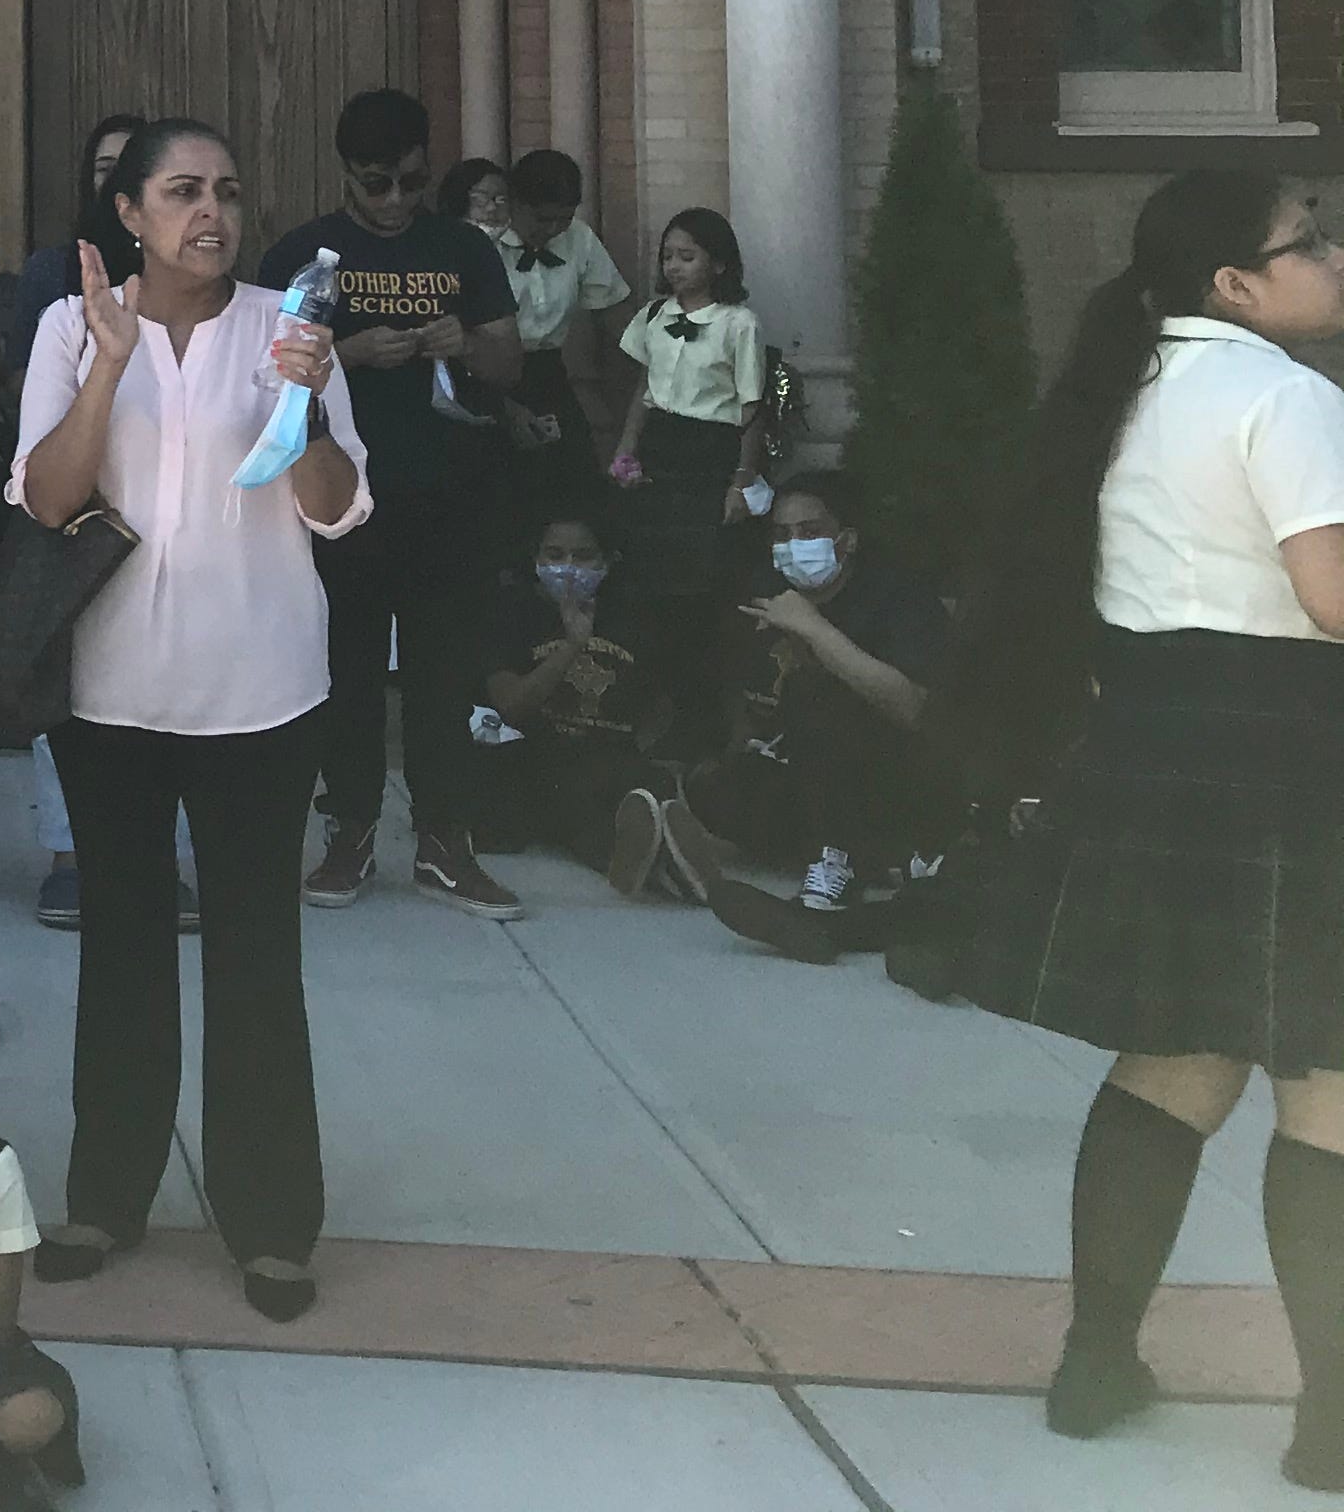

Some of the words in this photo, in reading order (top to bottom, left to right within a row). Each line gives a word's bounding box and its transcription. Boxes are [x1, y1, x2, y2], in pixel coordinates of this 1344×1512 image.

[334, 270, 402, 294] OTHER
[406, 272, 461, 295] SETON
[349, 296, 444, 315] SCHOOL
